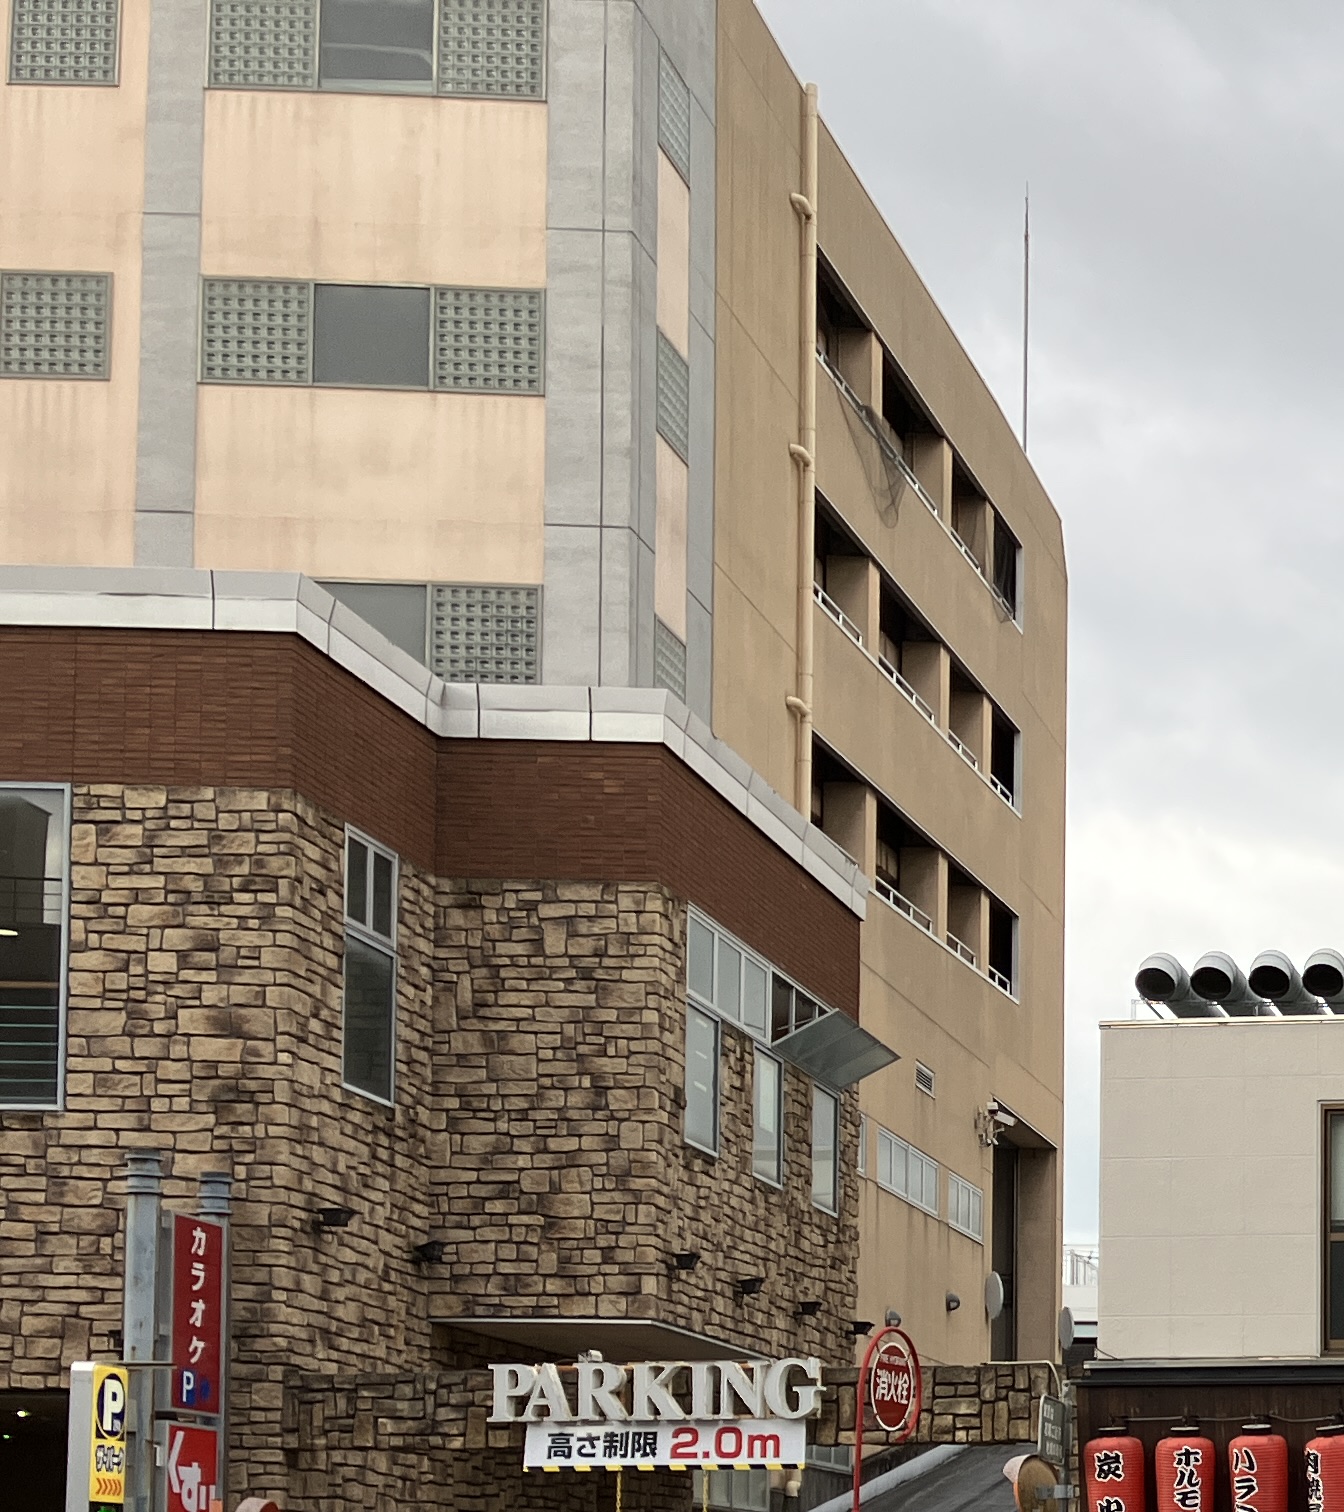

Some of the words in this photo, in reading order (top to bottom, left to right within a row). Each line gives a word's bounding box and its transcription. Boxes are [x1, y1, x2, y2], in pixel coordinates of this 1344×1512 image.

[188, 1226, 206, 1364] カラオケ
[103, 1379, 124, 1432] P
[487, 1357, 827, 1423] PARKING
[875, 1369, 910, 1405] 消火栓
[546, 1431, 658, 1460] 高さ制限
[669, 1427, 781, 1460] 2.0m
